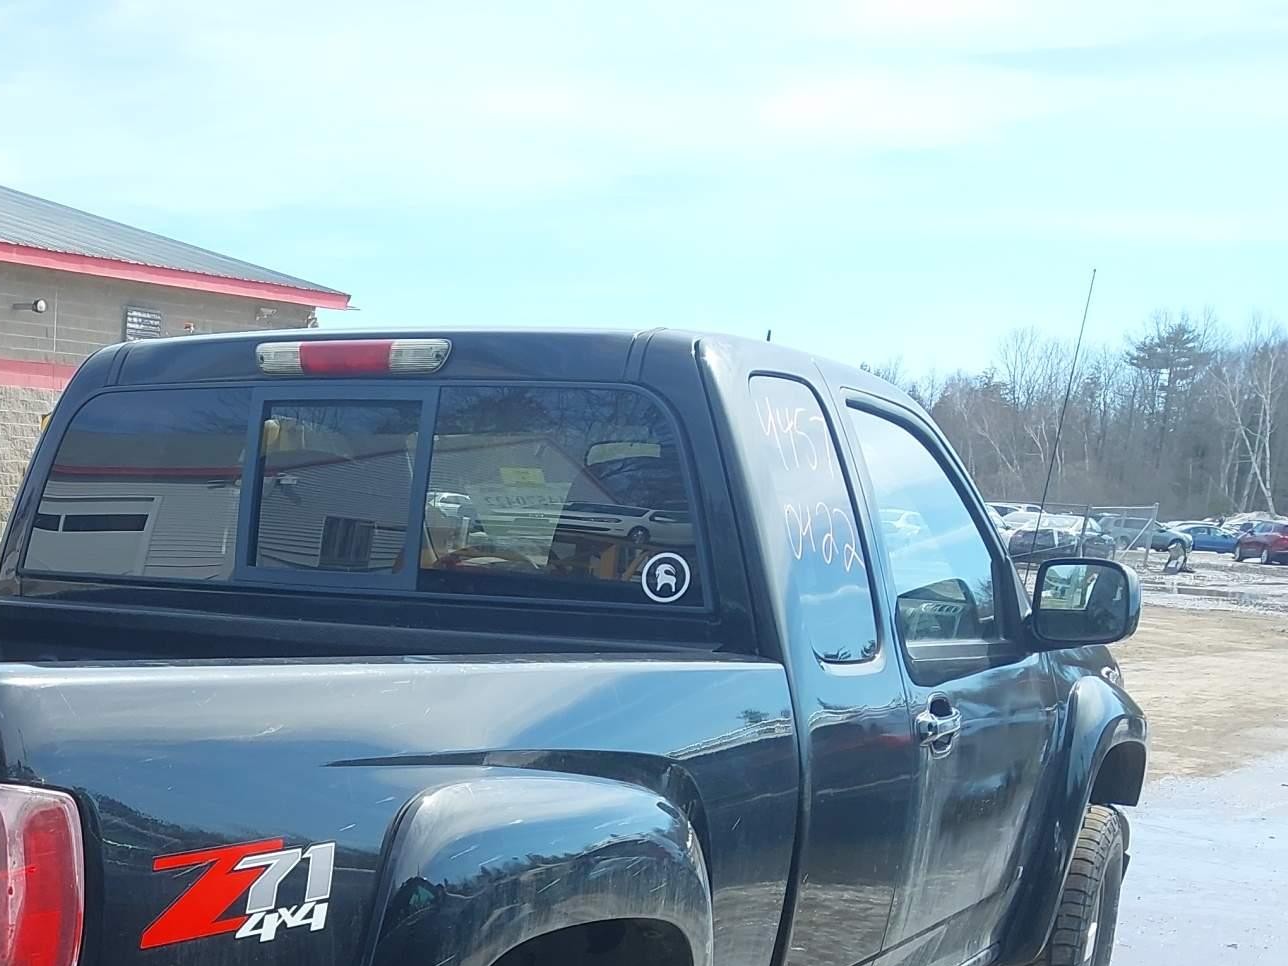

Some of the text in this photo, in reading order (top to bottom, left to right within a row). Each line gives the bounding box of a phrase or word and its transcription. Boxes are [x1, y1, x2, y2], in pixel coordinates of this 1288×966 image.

[755, 396, 835, 480] 4457
[784, 502, 866, 573] 0422
[140, 836, 337, 950] Z71
